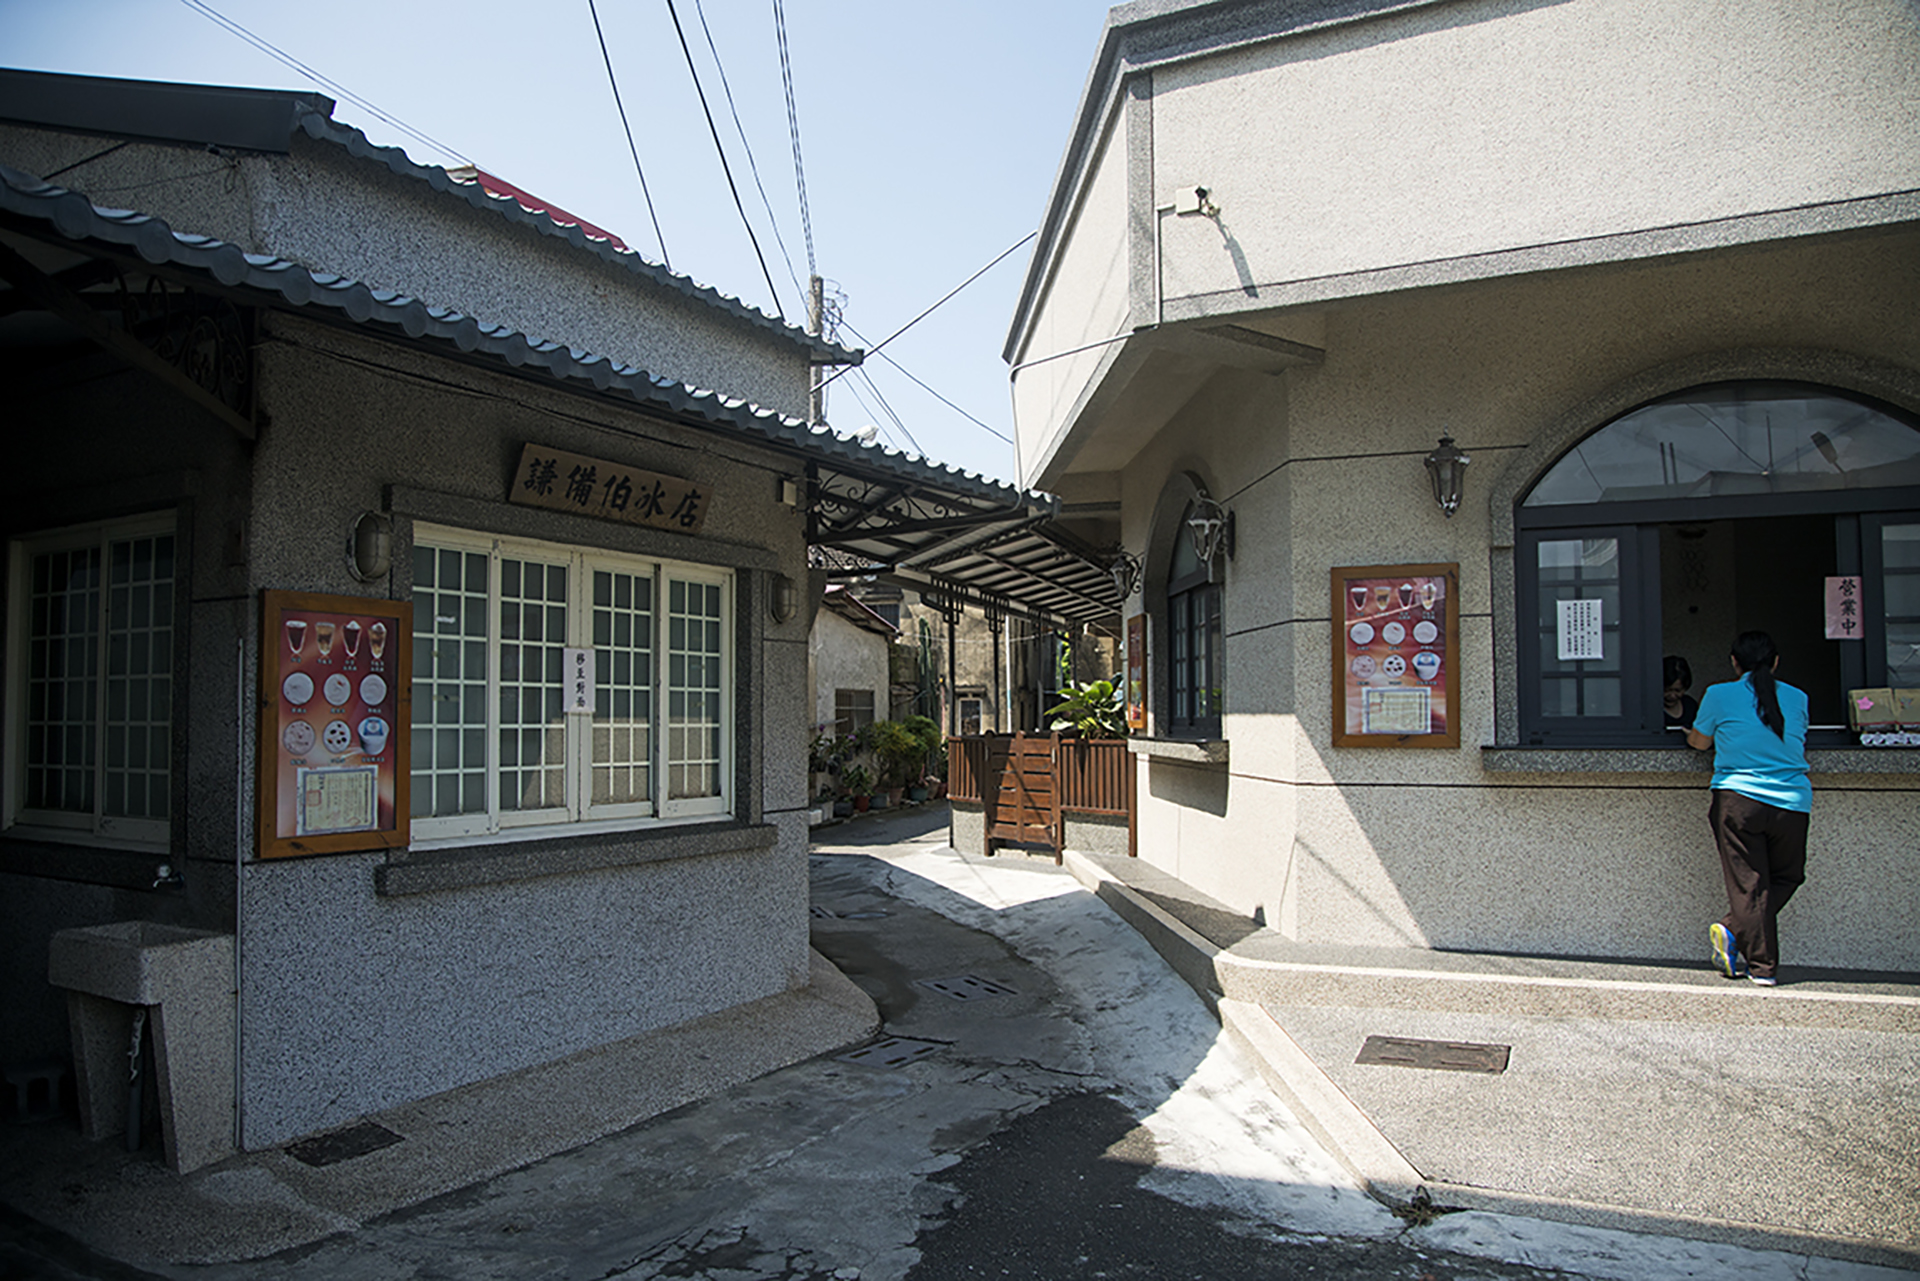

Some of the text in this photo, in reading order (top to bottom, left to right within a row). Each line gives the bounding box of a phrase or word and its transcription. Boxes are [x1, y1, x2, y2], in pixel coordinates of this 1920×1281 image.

[523, 457, 702, 528] 謙備伯冰店
[1839, 578, 1858, 636] 營業中
